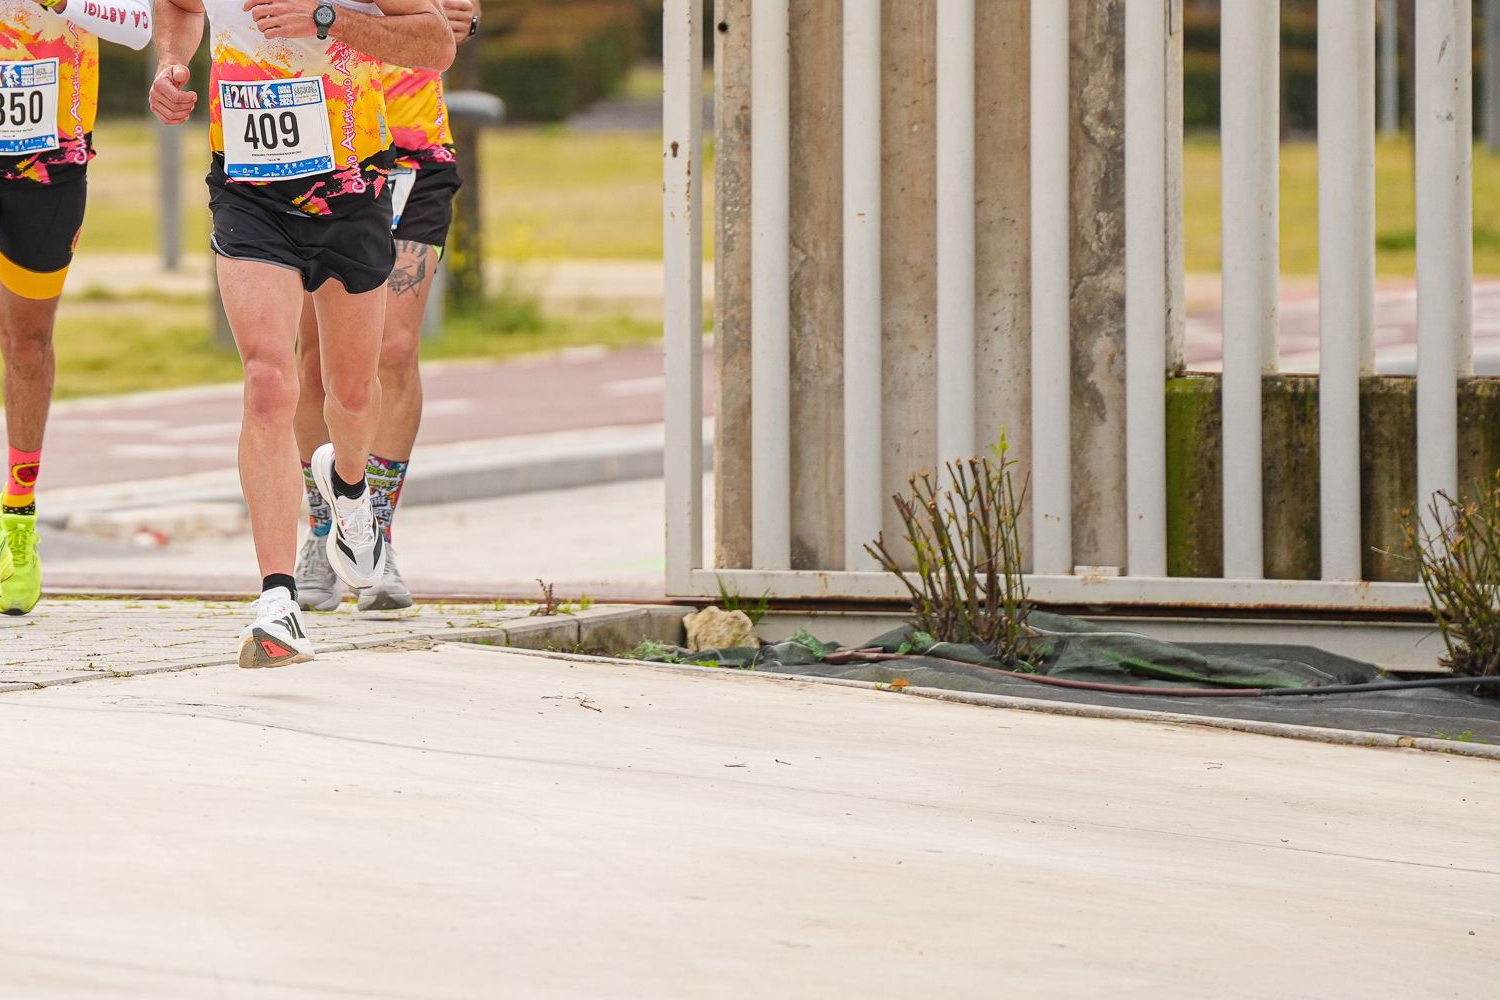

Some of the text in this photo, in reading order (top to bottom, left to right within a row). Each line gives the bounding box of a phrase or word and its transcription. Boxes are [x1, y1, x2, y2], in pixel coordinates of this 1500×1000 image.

[84, 0, 127, 25] ASTIGI
[230, 85, 261, 109] 21K
[340, 79, 356, 152] Atletismo
[73, 125, 88, 165] Club
[244, 111, 300, 149] 409
[347, 155, 367, 193] Club
